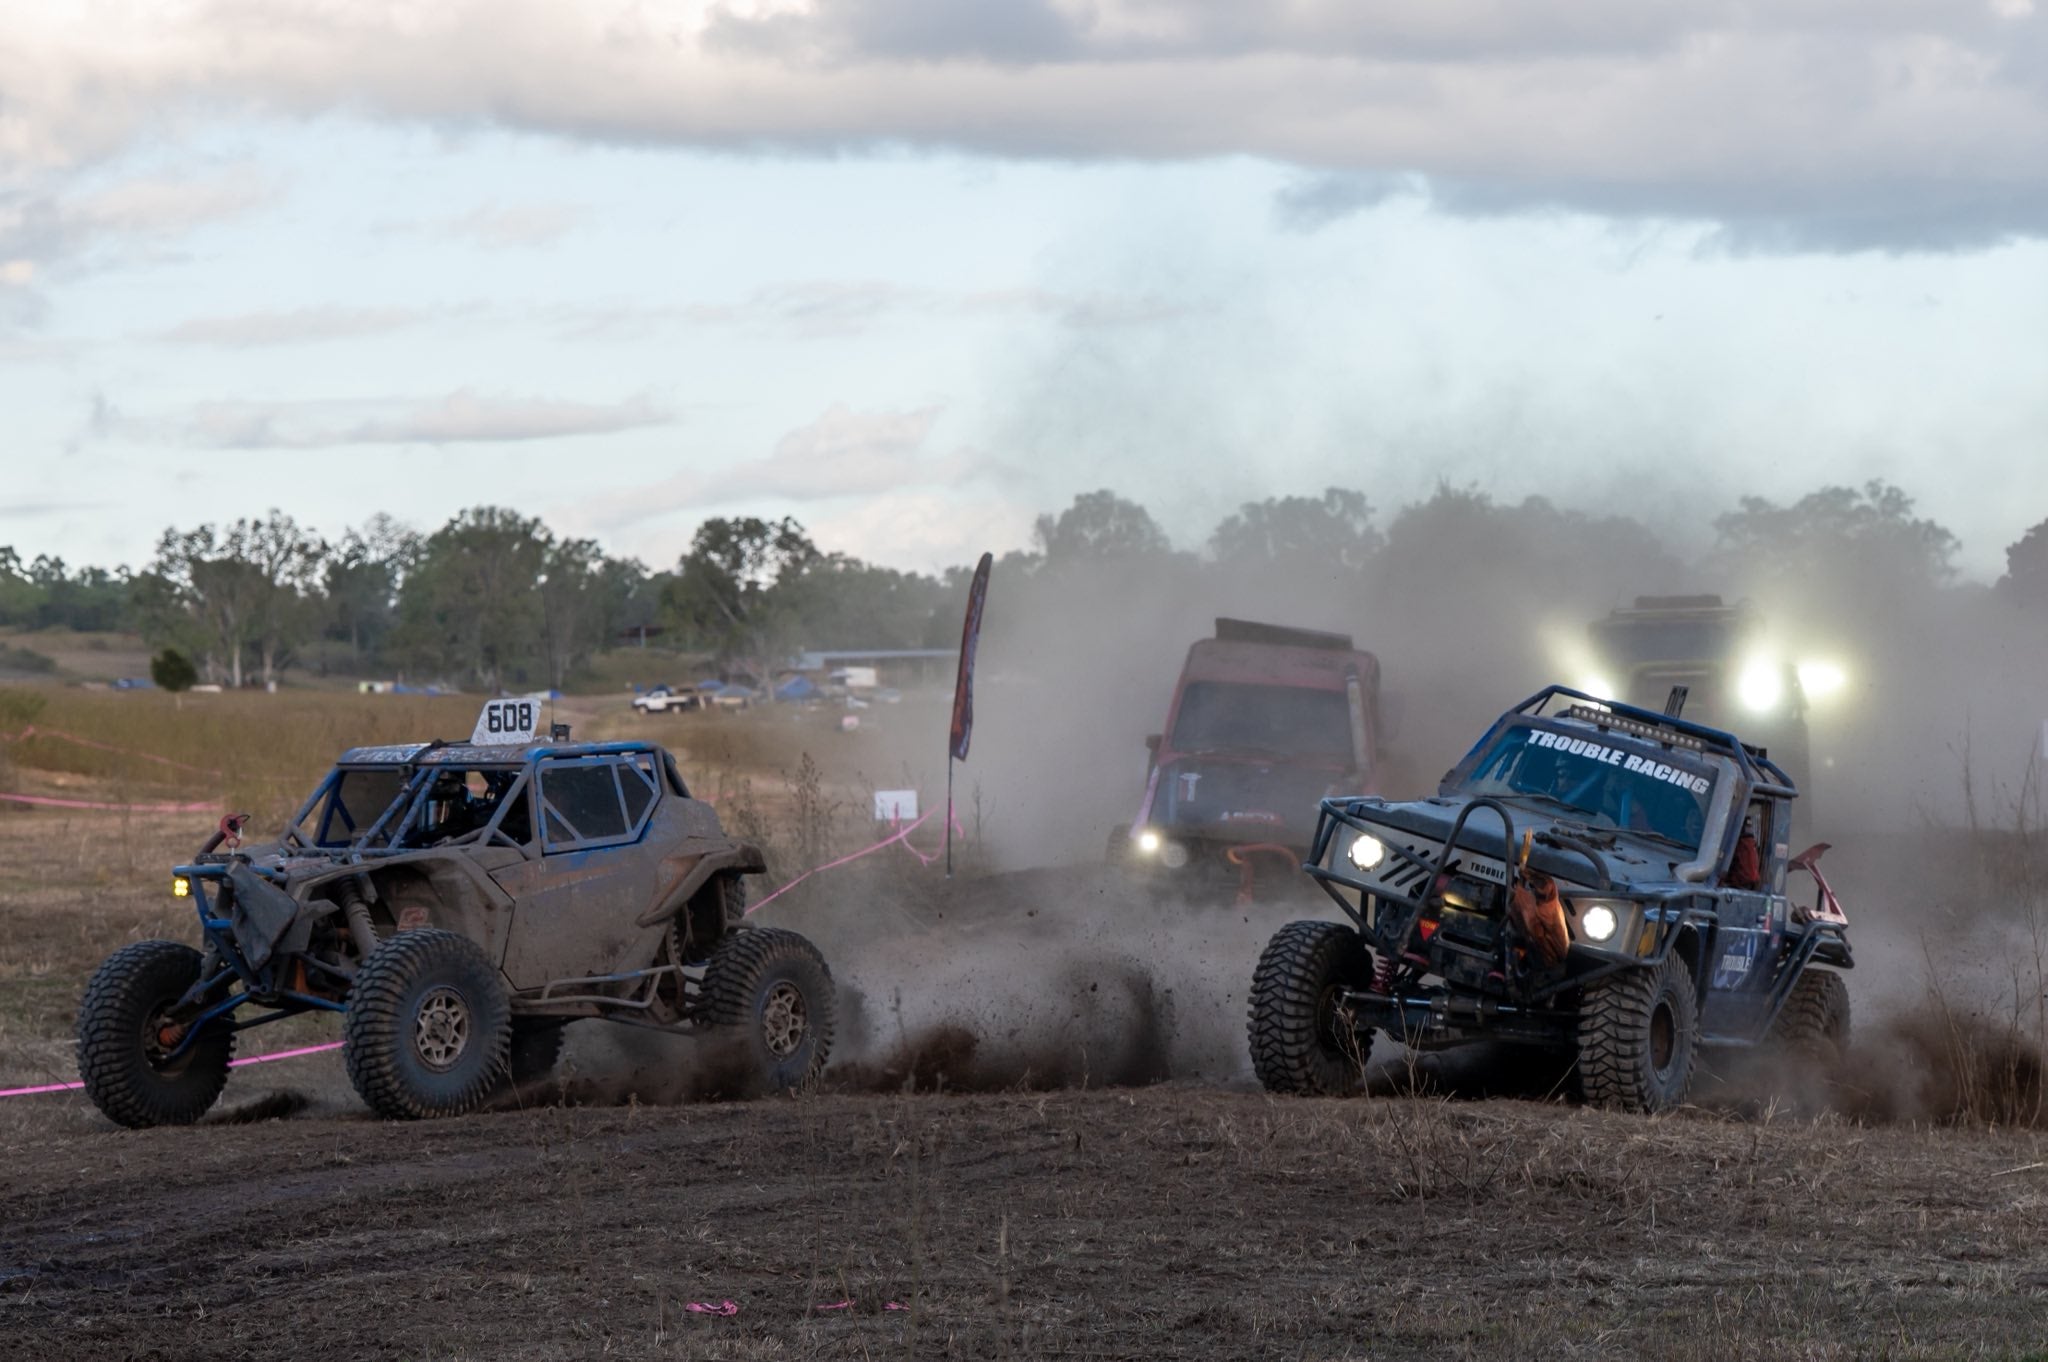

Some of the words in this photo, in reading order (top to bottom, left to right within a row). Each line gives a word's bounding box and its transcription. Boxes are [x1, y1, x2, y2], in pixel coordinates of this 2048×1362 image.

[488, 703, 532, 733] 608
[1528, 729, 1625, 766] TROUBLE
[1623, 754, 1710, 794] RACING
[1470, 862, 1505, 880] TROUBLE
